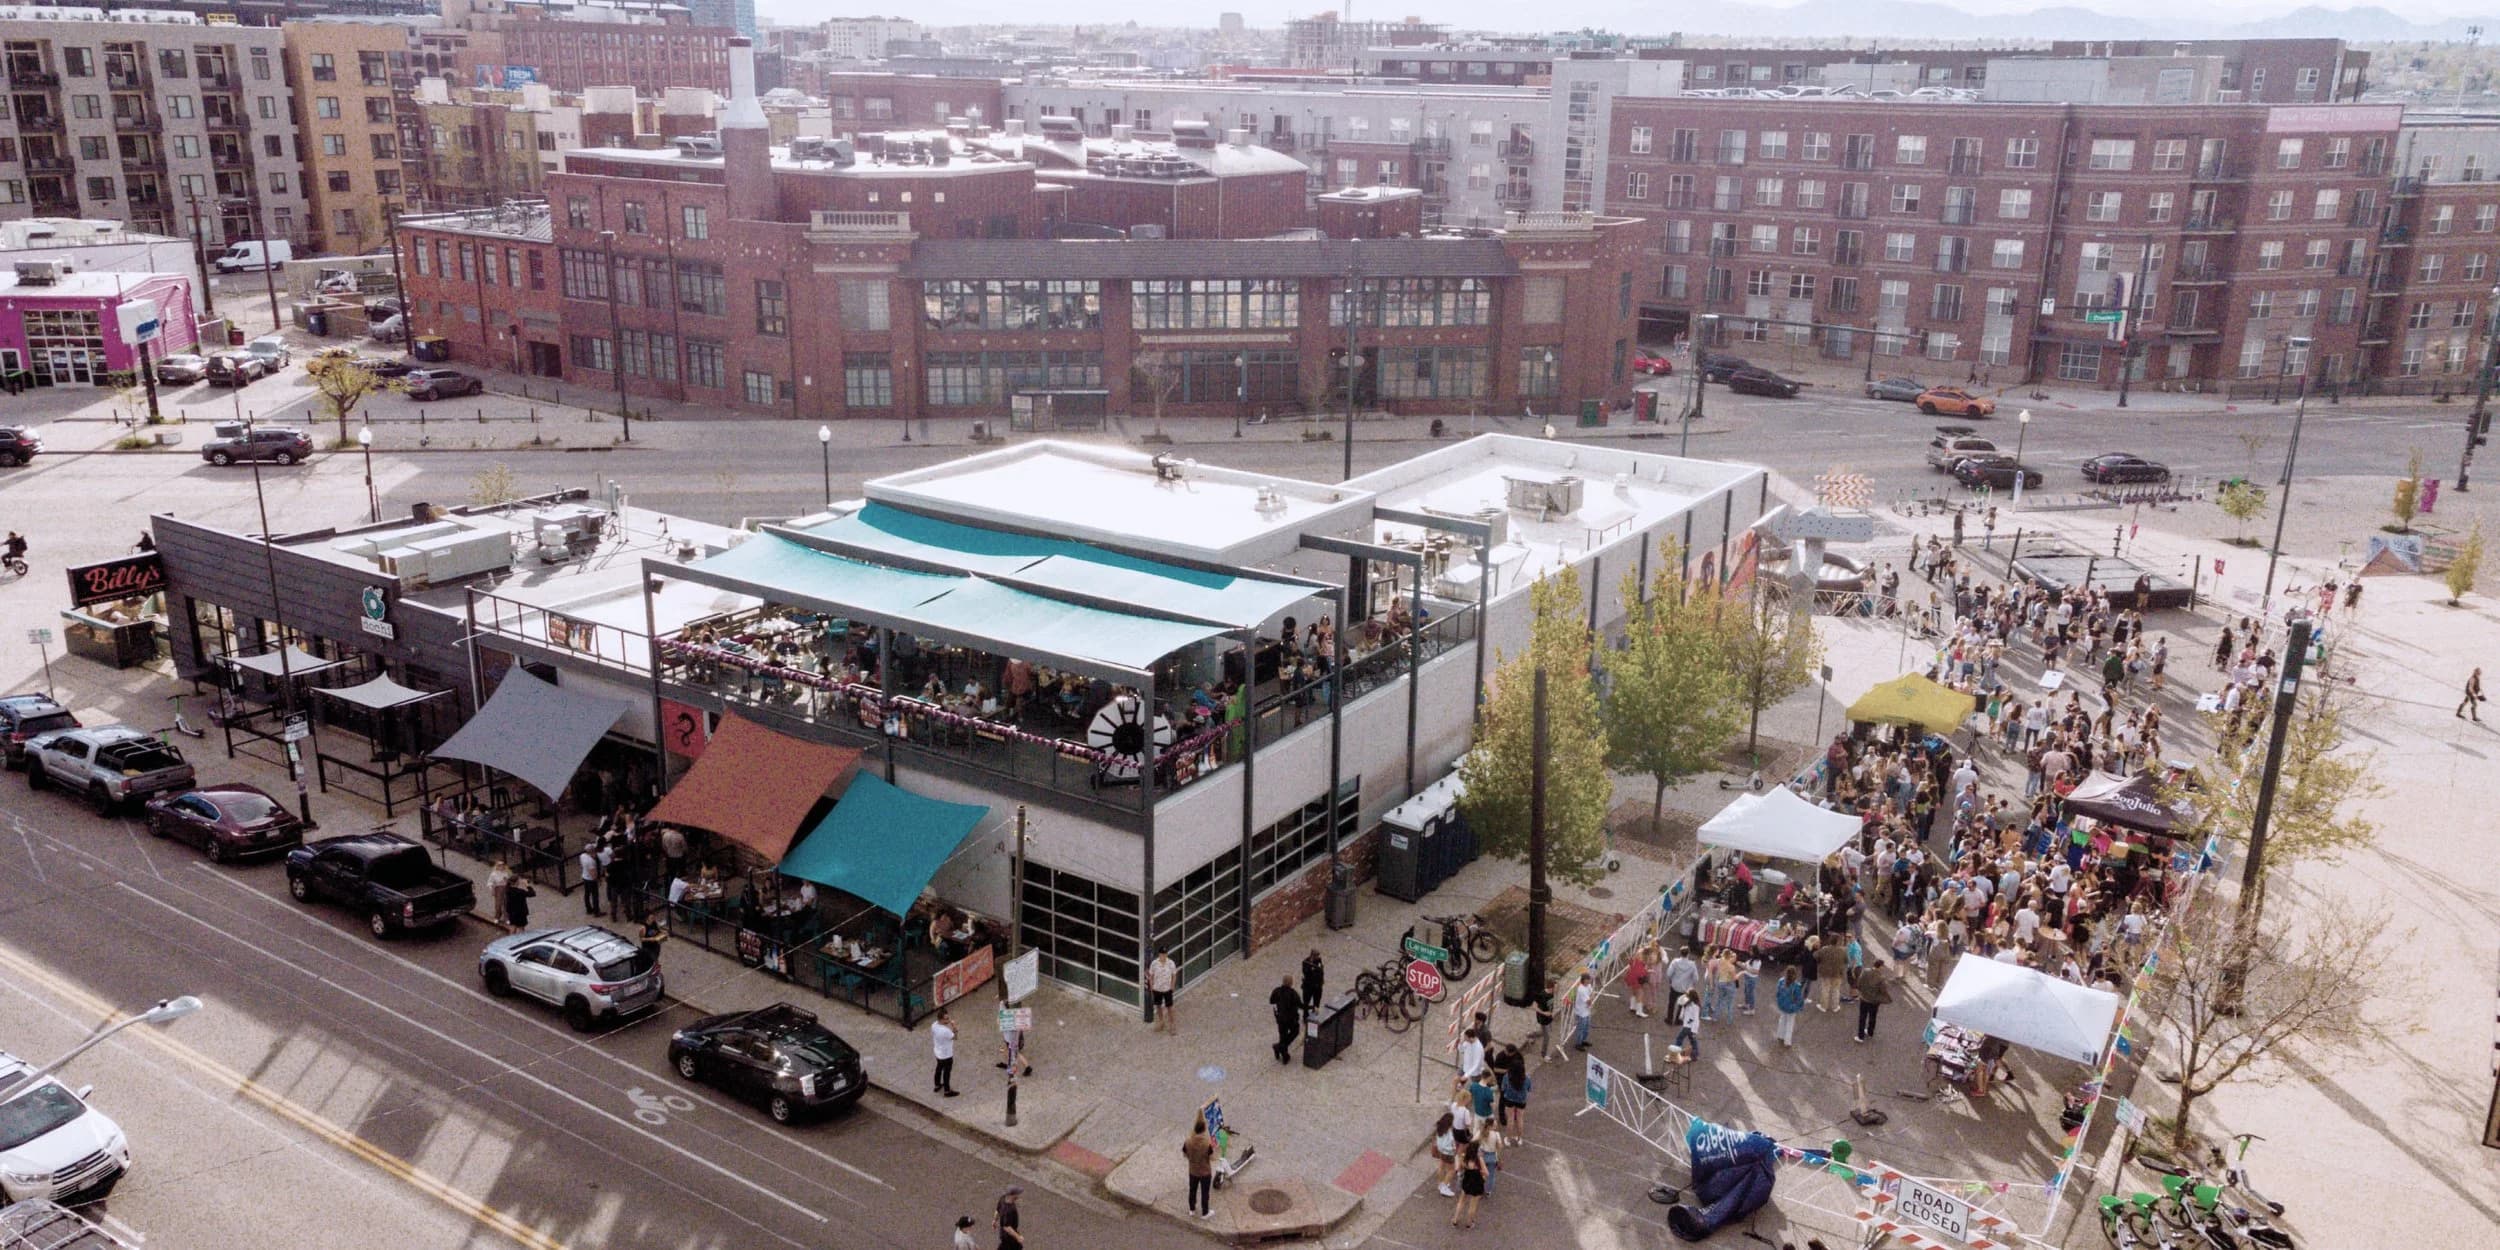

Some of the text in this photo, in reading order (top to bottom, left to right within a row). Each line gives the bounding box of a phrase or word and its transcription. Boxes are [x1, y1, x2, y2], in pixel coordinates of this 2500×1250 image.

[1408, 968, 1440, 989] STOP
[1913, 1188, 1954, 1215] ROAD
[1903, 1200, 1960, 1234] CLOSED
